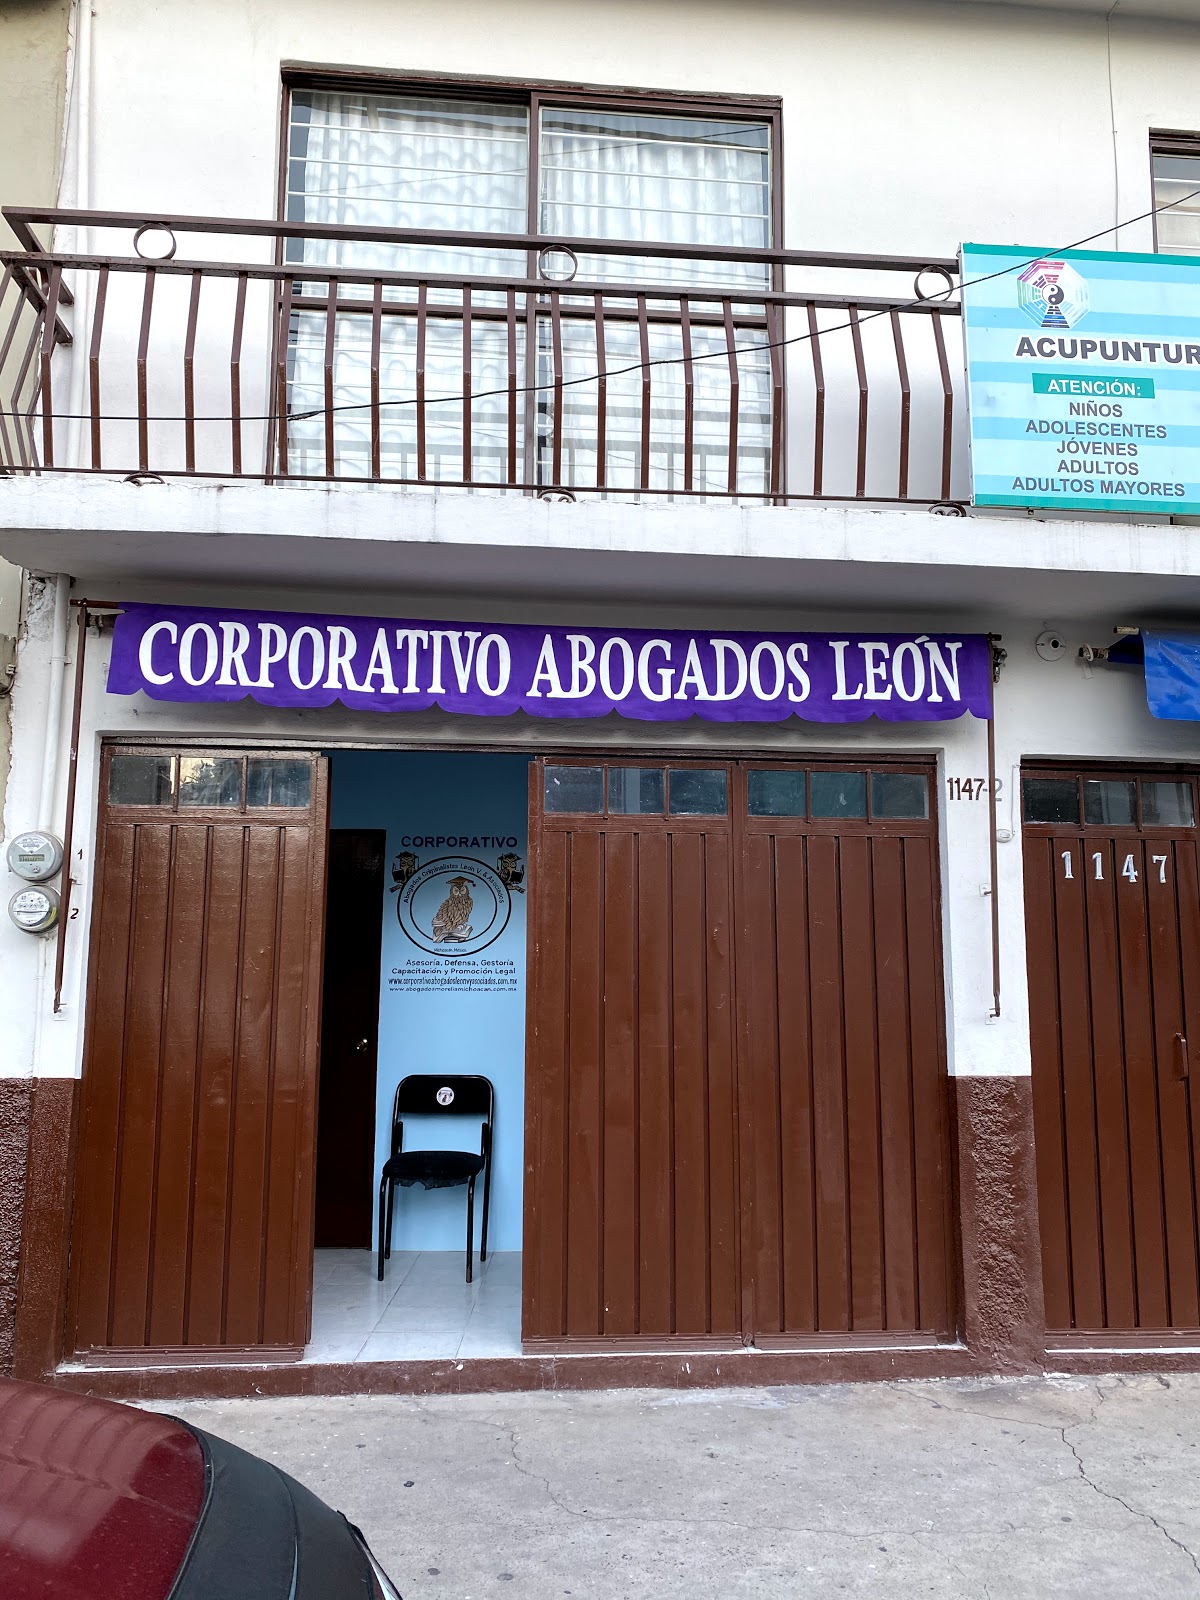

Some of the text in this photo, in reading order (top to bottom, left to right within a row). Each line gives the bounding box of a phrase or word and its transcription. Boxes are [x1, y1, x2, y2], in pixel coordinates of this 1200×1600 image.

[1016, 336, 1200, 365] ACUPUNTUR
[1048, 379, 1142, 397] ATENCIÓN:
[1069, 400, 1123, 418] NIÑOS
[1025, 419, 1168, 439] ADOLESCENTES
[1056, 437, 1138, 457] JÓVENES
[1057, 459, 1140, 476] ADULTOS
[1011, 477, 1186, 497] ADULTOS MAYORES
[138, 620, 963, 703] CORPORATIVO ABOGADOS LEÓN
[400, 835, 518, 848] CORPORATIVO
[77, 848, 83, 860] 1
[70, 907, 79, 919] 2
[391, 967, 442, 976] Capacitación
[450, 967, 493, 975] Promoción
[495, 968, 516, 976] Legal
[405, 959, 514, 967] Asesoría, Defensa, Gestoría
